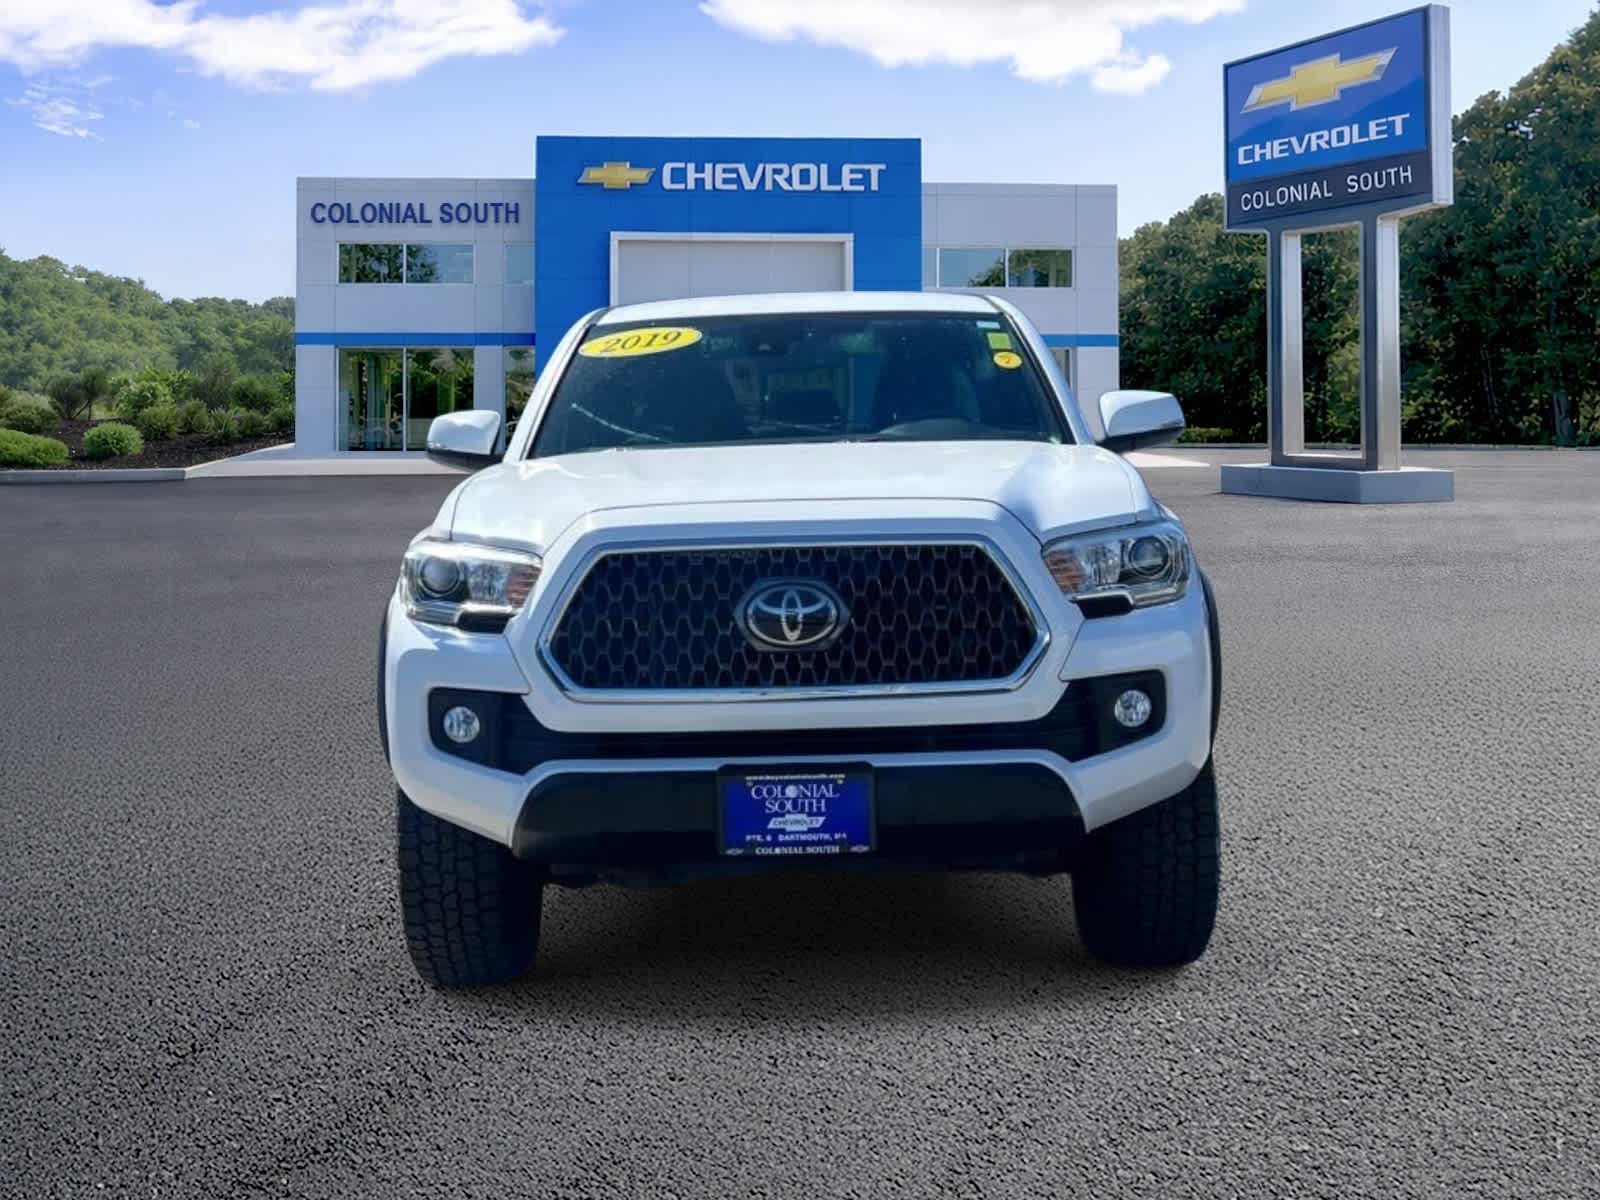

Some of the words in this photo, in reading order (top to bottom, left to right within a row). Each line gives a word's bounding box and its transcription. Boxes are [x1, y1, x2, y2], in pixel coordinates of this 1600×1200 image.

[1237, 112, 1411, 166] CHEVROLET
[661, 161, 888, 192] CHEVROLET
[1240, 180, 1334, 212] COLONIAL
[1346, 165, 1413, 194] SOUTH
[310, 202, 433, 225] COLONIAL
[438, 201, 521, 225] SOUTH
[600, 330, 682, 353] 2019
[751, 784, 840, 799] COLONIAL
[765, 799, 827, 814] SOUTH
[755, 846, 803, 856] COLONIAL
[805, 845, 840, 855] SOUTH
